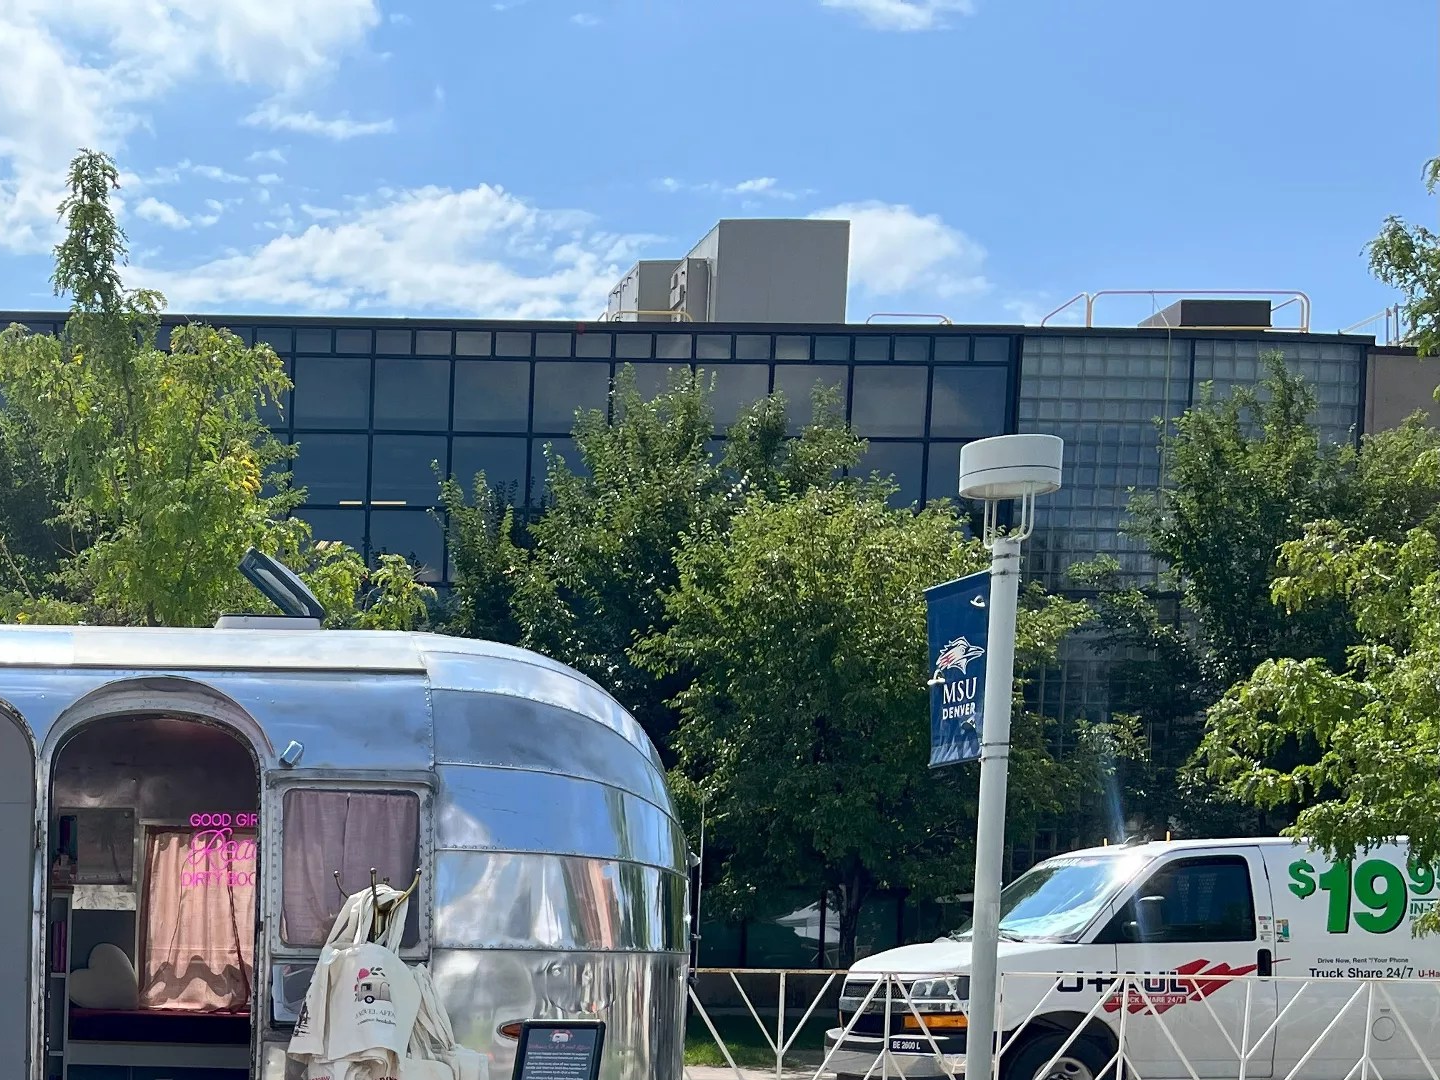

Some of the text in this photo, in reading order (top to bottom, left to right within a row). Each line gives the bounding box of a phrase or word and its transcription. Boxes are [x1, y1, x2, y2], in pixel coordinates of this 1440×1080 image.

[943, 677, 977, 704] MSU
[942, 702, 976, 720] DENVER
[190, 813, 232, 827] GOOD
[188, 827, 257, 872] Rea
[182, 871, 223, 887] DIRTY
[1309, 967, 1345, 978] Truck
[1347, 967, 1383, 978] Share
[1386, 966, 1414, 979] 24/7
